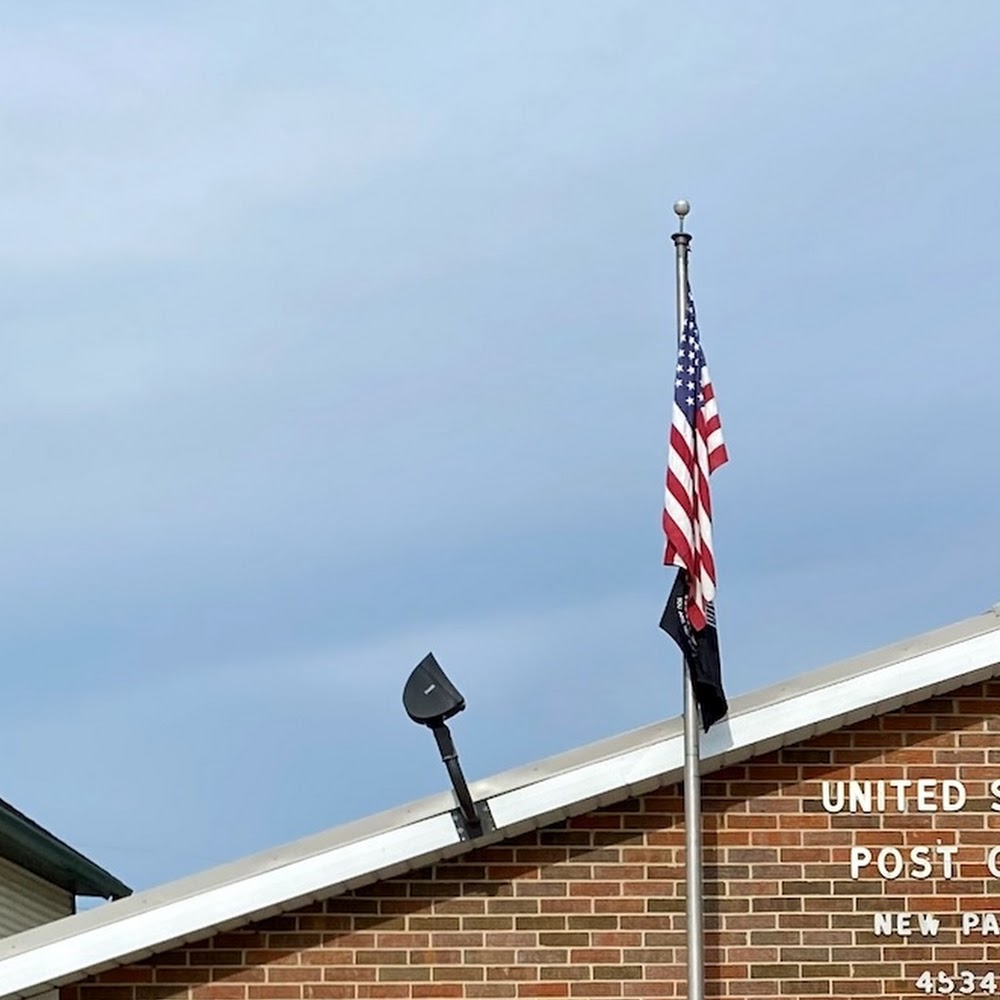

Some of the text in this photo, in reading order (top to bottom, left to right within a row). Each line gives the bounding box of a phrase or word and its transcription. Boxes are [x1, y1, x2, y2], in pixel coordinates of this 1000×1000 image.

[821, 779, 967, 813] UNITED
[850, 845, 958, 879] POST
[873, 912, 940, 936] NEW
